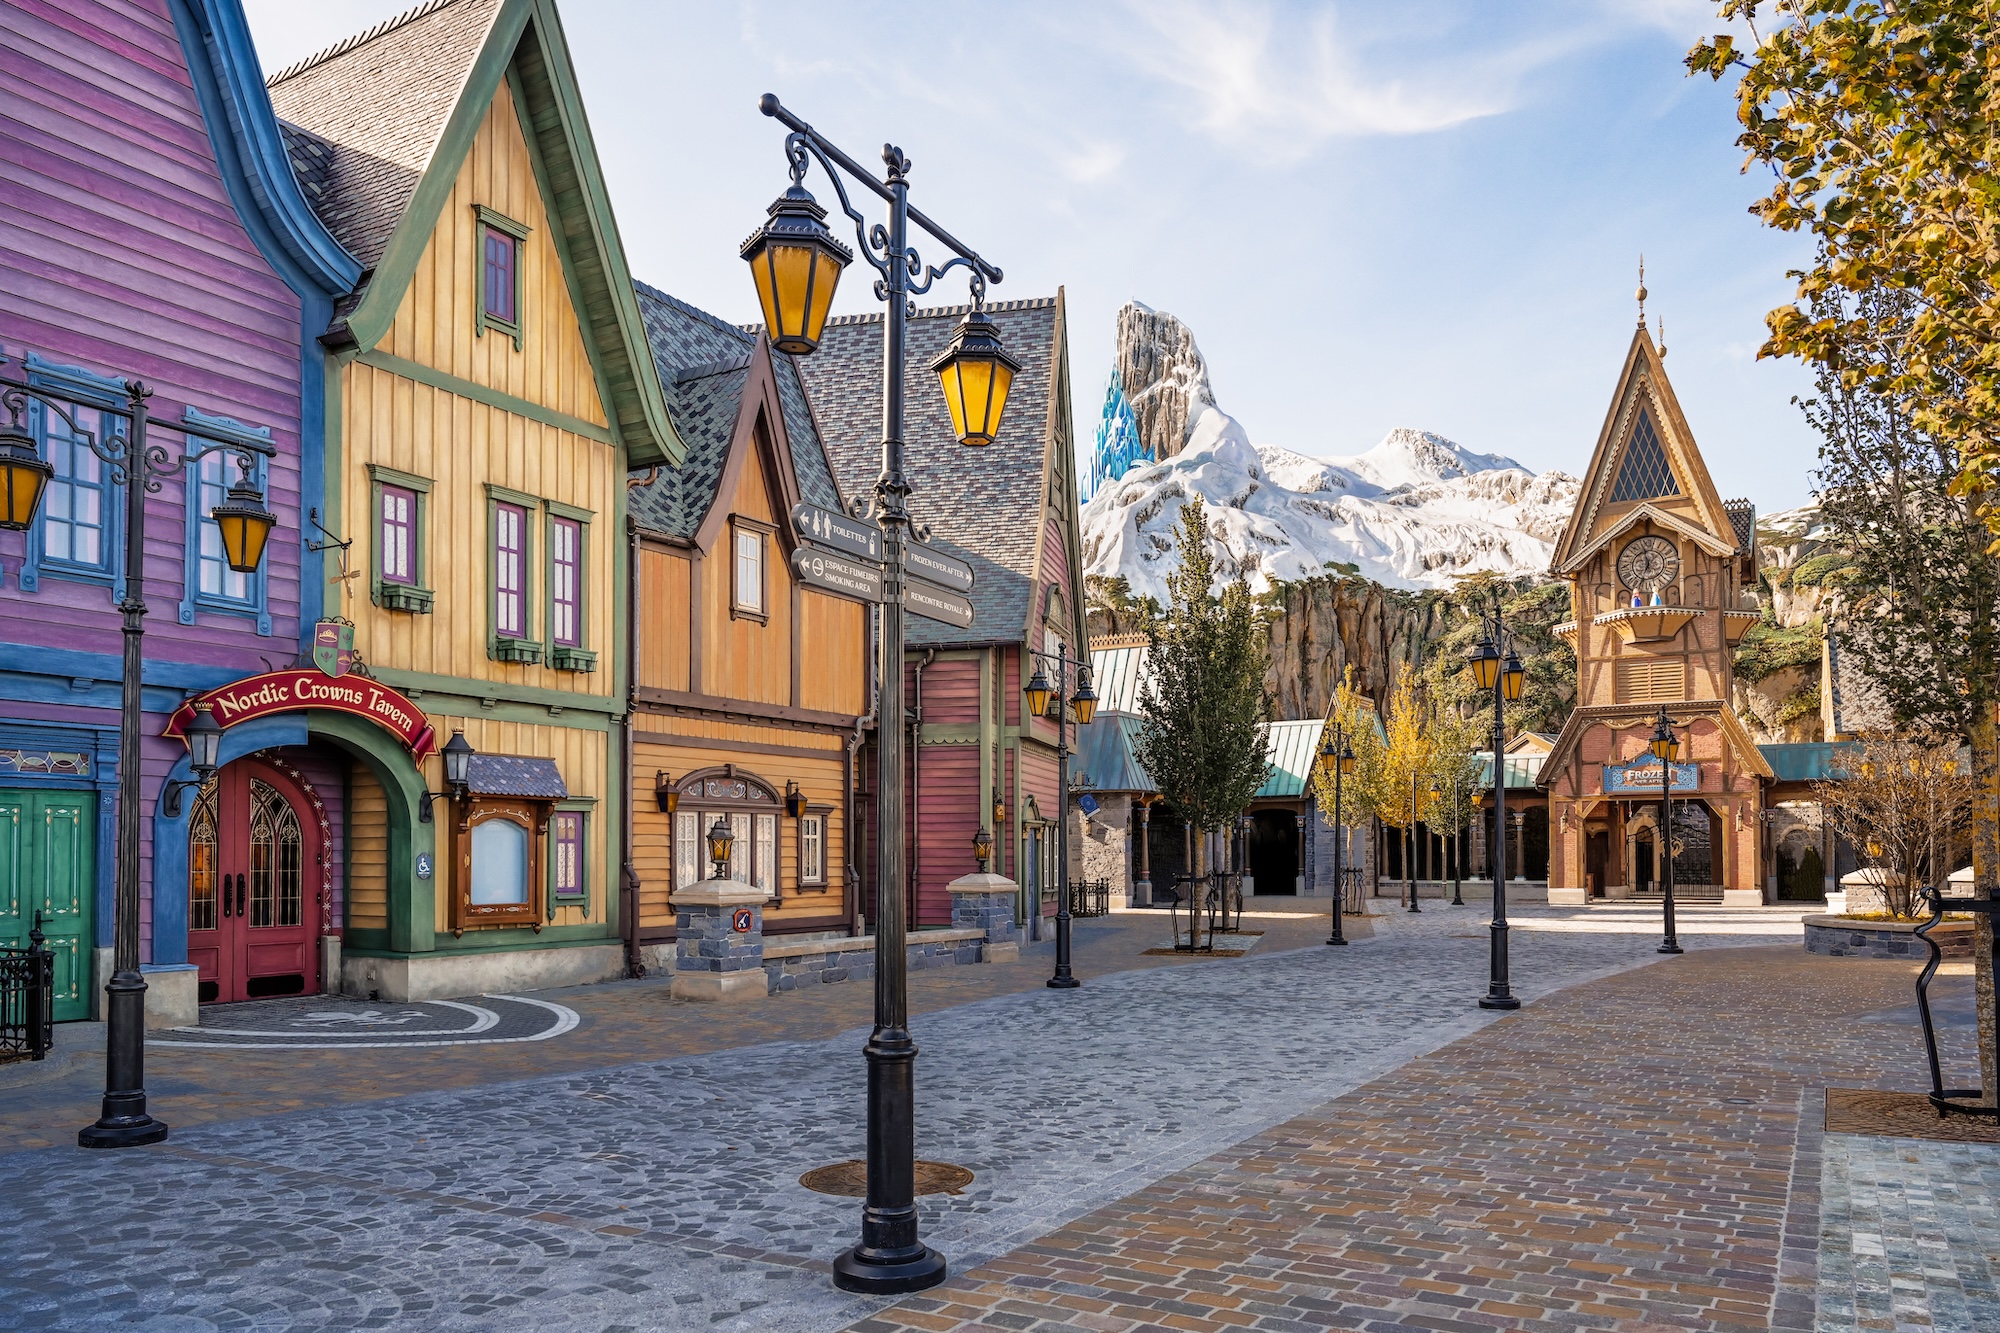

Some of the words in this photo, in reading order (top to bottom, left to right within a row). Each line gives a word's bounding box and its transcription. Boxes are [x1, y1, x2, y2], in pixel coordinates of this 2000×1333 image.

[832, 525, 867, 544] TOILETTES
[825, 560, 848, 574] ESPACE
[849, 568, 879, 583] FUMEURS
[911, 553, 932, 567] FROZEN
[933, 561, 946, 573] EVER
[947, 568, 964, 579] AFTER
[824, 572, 854, 588] SMOKING
[855, 583, 872, 593] AREA
[910, 591, 943, 609] RENCONTRE
[943, 602, 964, 615] ROYALE
[216, 682, 289, 719] Nordic
[294, 677, 363, 705] Crowns
[369, 688, 414, 733] Tavern
